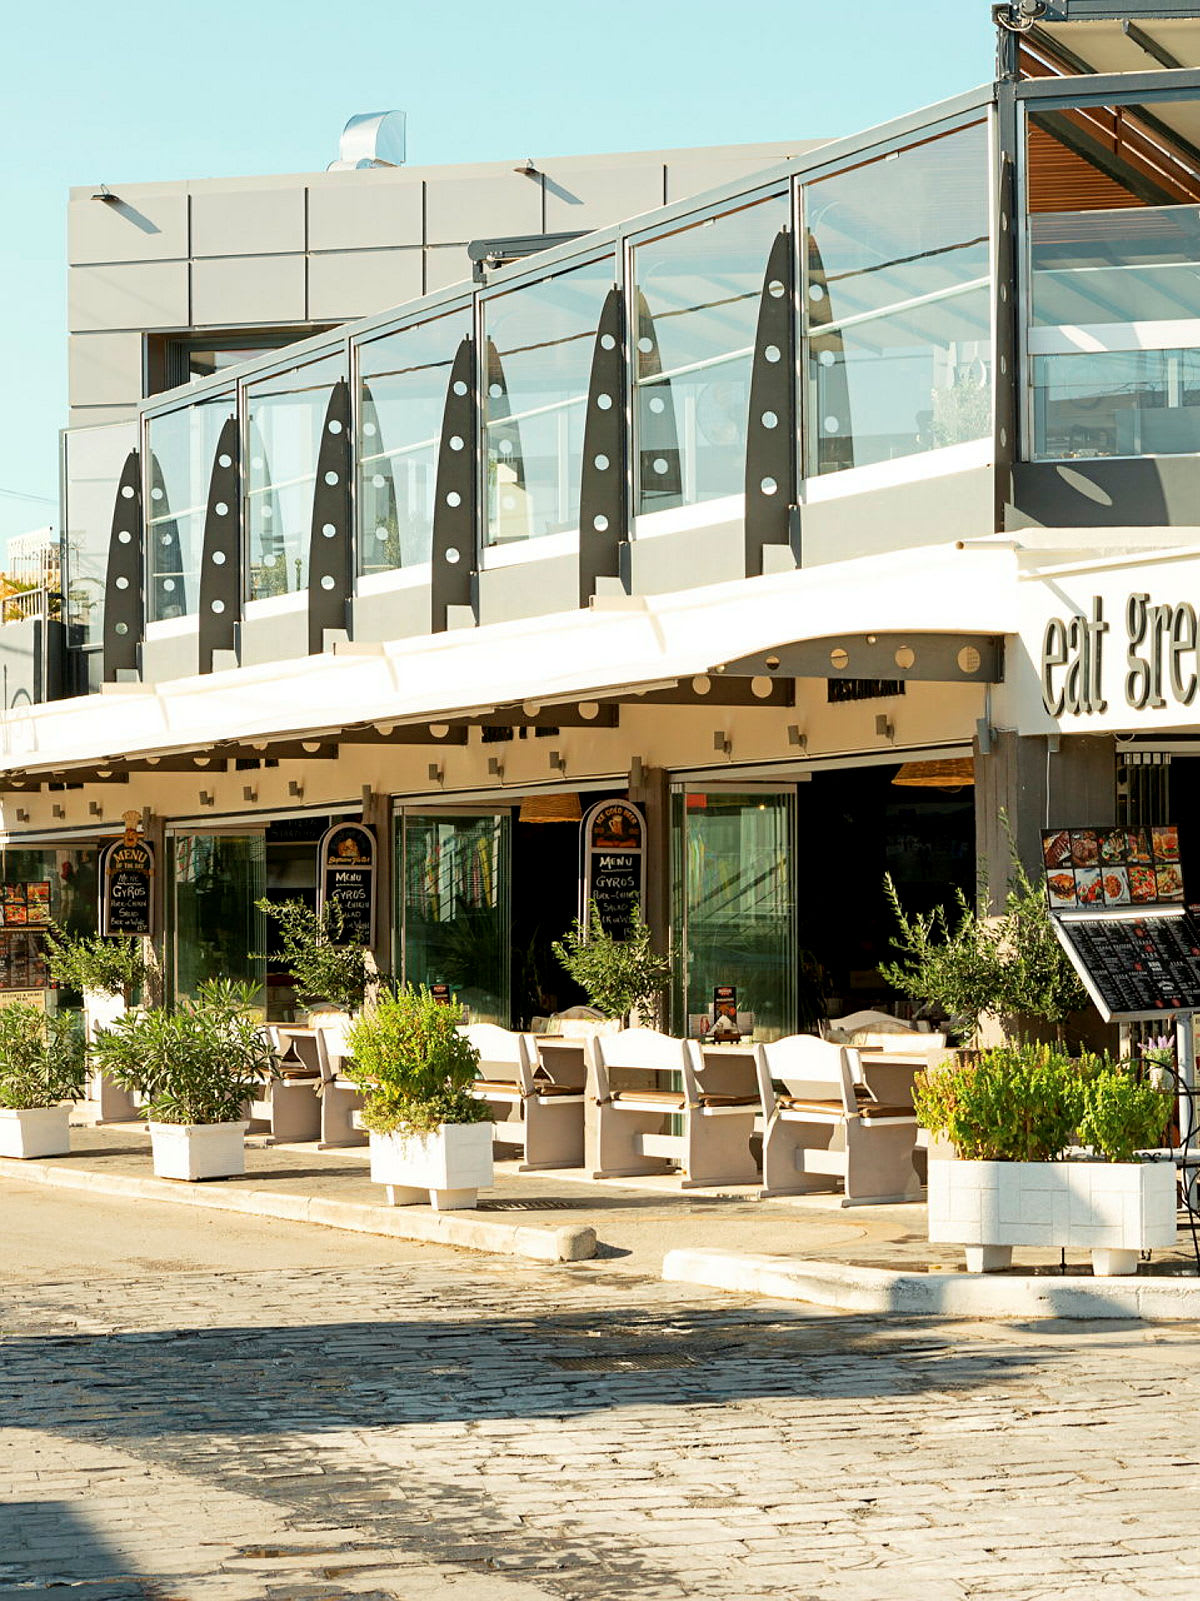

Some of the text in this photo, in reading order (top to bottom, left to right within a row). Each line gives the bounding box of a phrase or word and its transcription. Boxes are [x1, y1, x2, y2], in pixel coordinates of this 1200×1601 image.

[1041, 595, 1109, 719] eat
[113, 849, 148, 863] MENU
[596, 876, 634, 888] GYROS
[332, 889, 366, 900] GYROS
